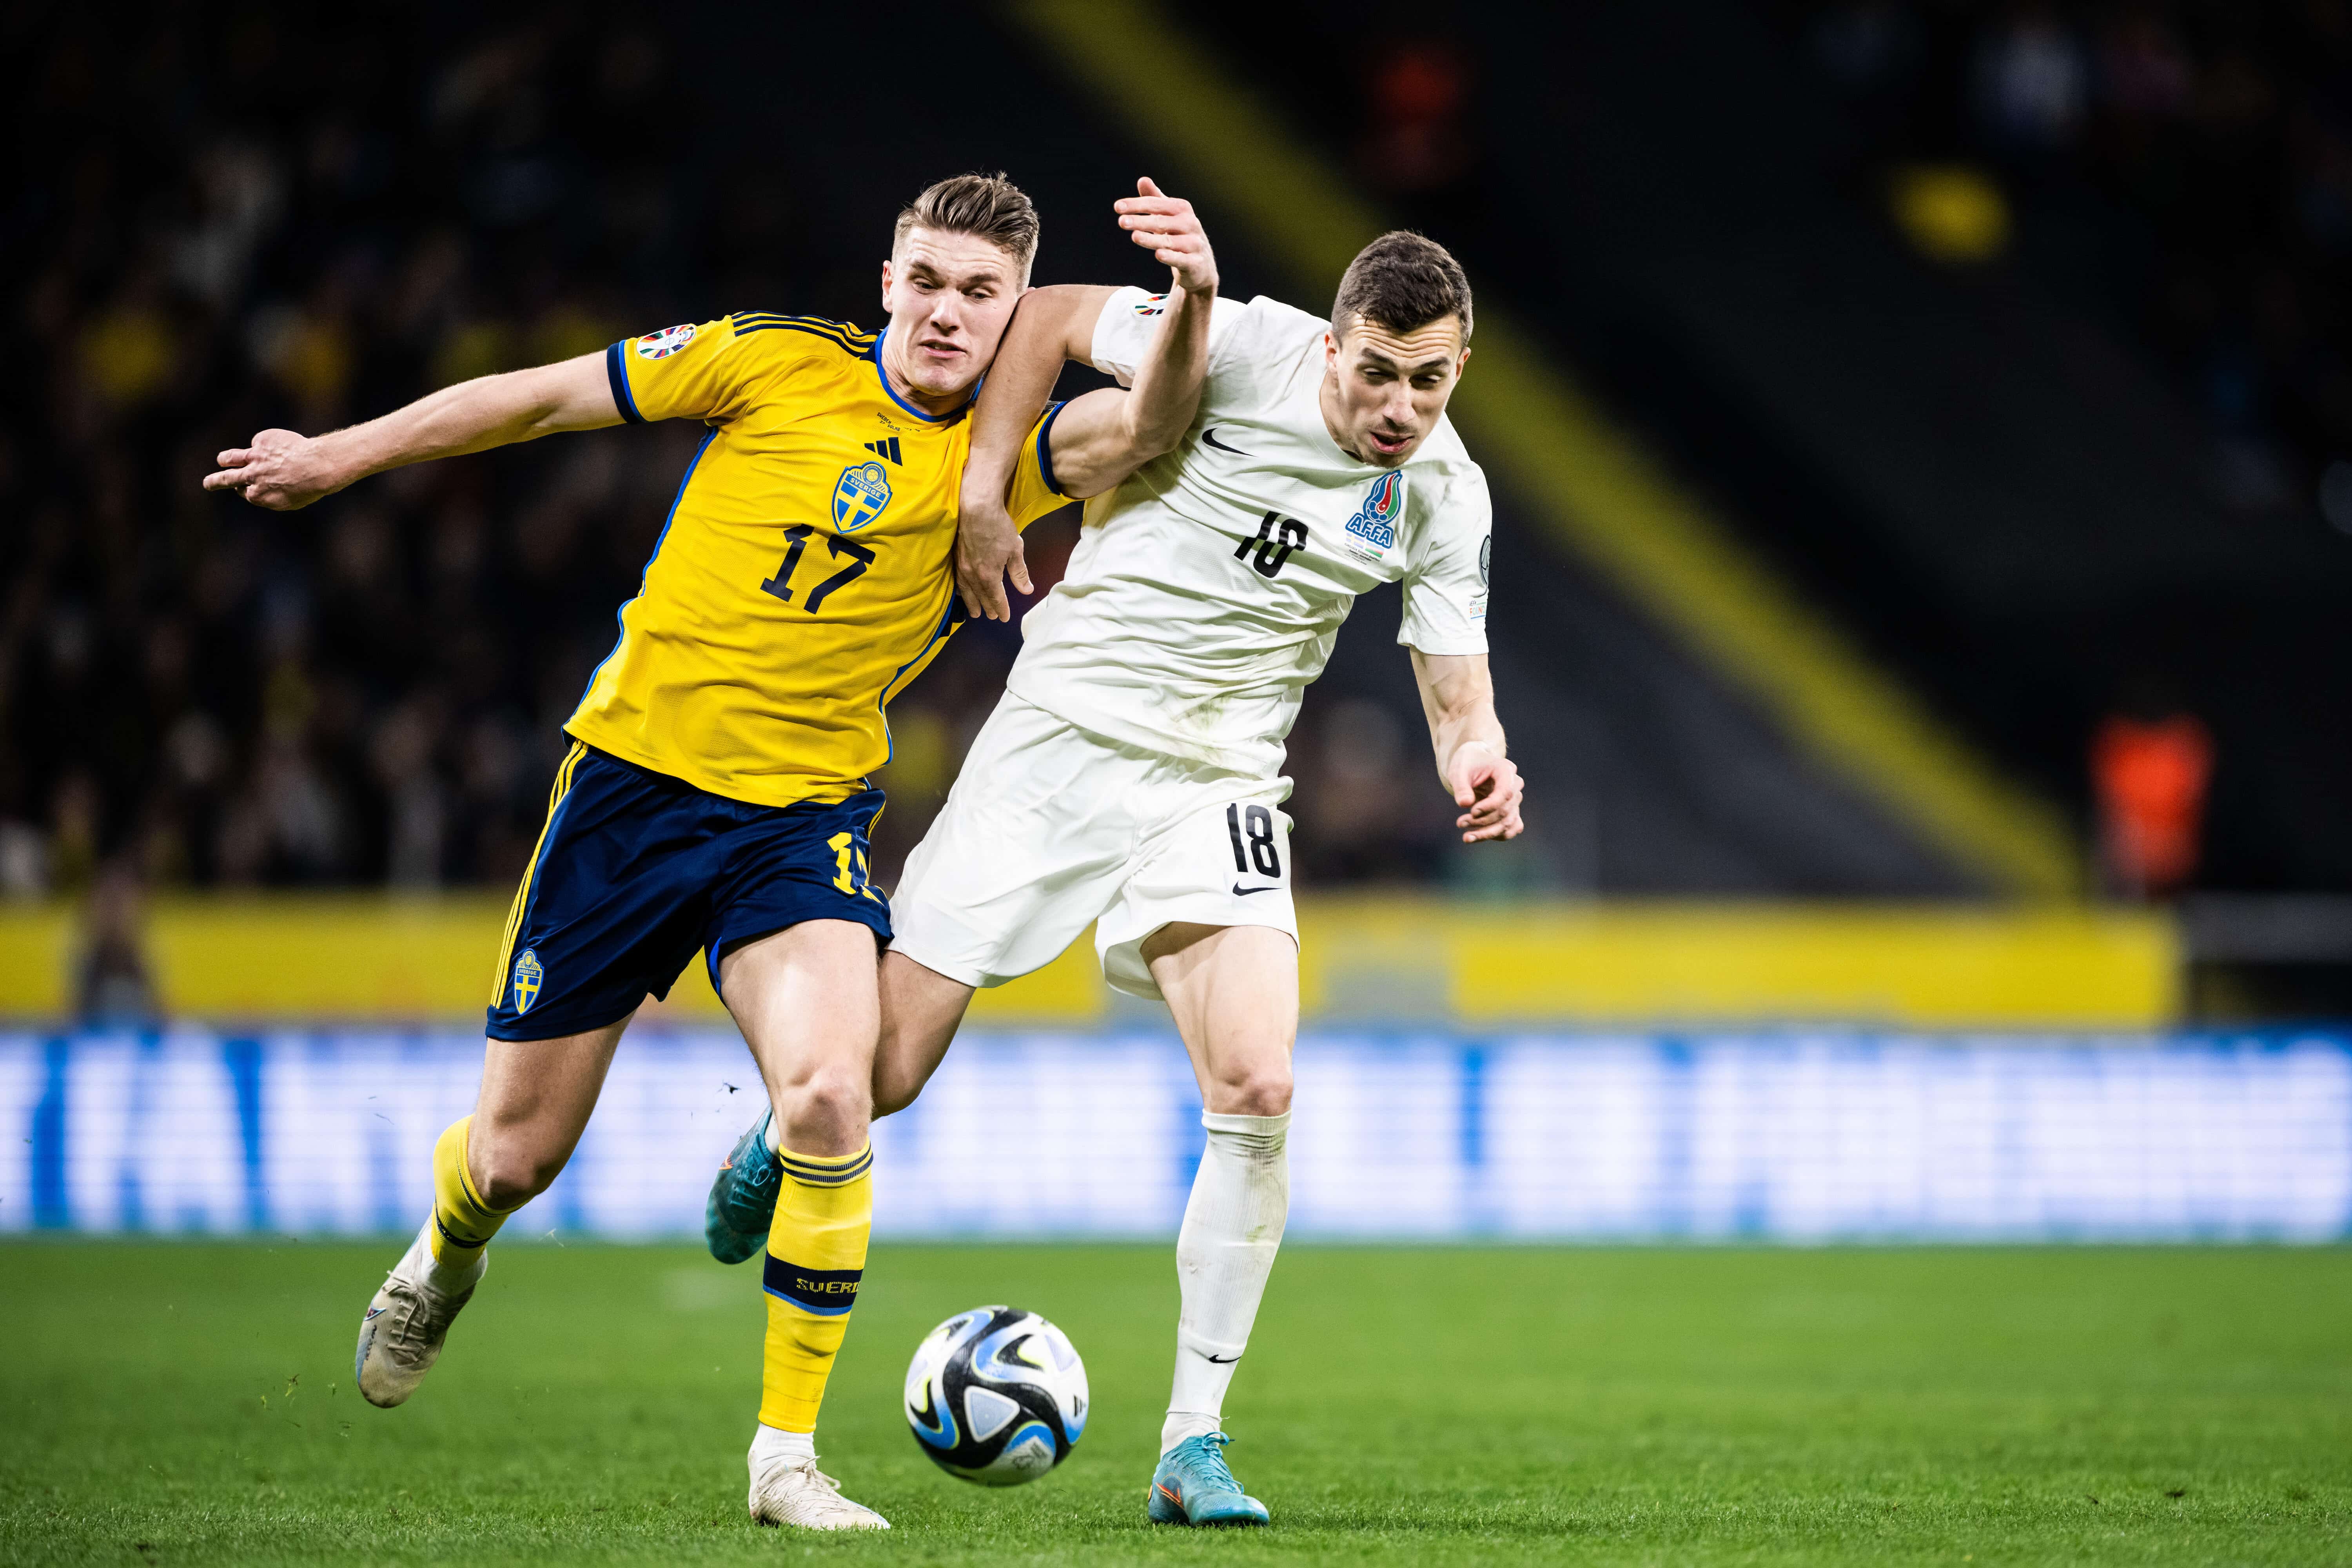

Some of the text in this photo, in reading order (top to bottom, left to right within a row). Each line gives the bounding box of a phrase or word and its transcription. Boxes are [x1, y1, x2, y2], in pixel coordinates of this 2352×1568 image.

[877, 412, 892, 424] SWEDEN
[850, 477, 881, 498] SVERIGE
[1348, 515, 1392, 547] AFFA
[760, 523, 876, 615] 17
[1227, 802, 1281, 878] 18
